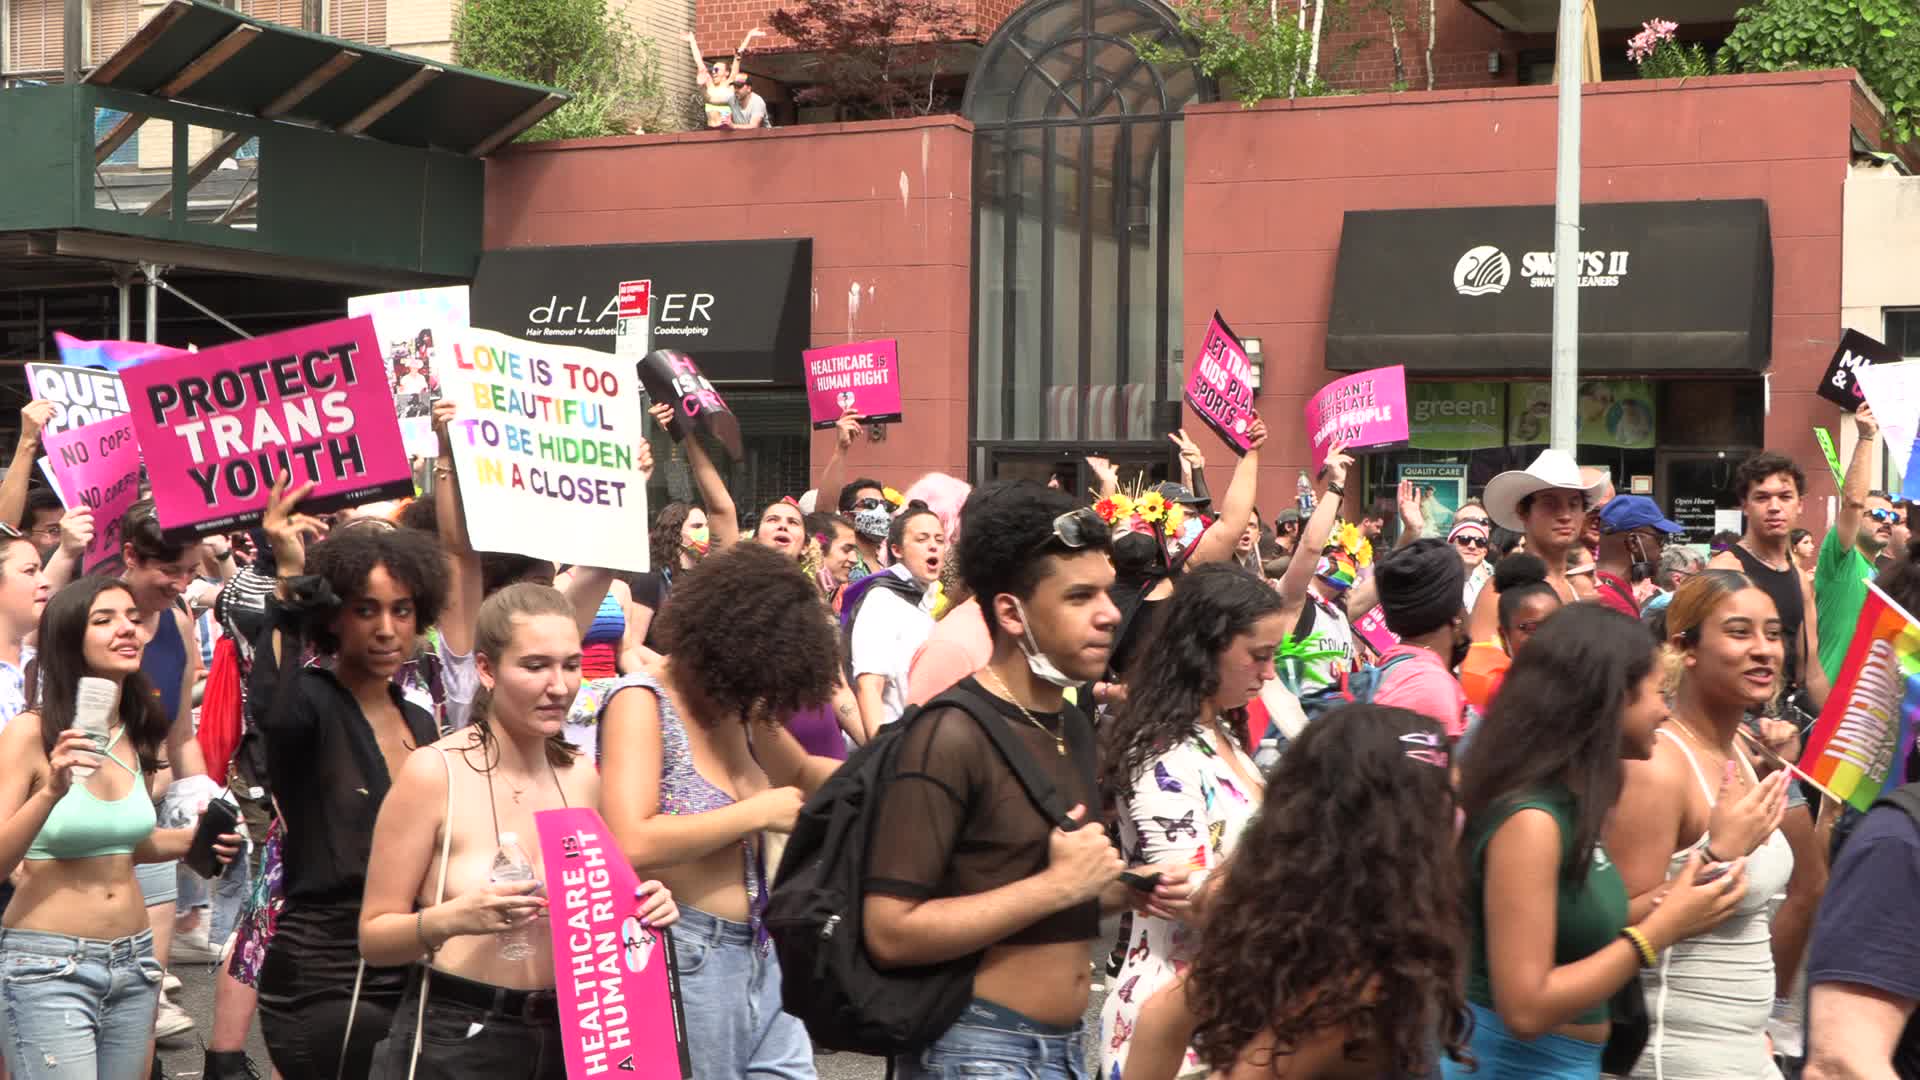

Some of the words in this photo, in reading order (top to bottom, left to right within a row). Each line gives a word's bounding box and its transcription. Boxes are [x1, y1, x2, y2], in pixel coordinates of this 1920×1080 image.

[1520, 251, 1605, 277] SW'S
[1608, 251, 1629, 275] II
[1576, 276, 1619, 287] LEANERS
[529, 293, 715, 323] drLAER
[526, 327, 543, 337] Hair
[544, 327, 576, 337] Removal
[584, 326, 617, 337] Aestheti
[654, 326, 709, 336] Coolsculpting
[453, 343, 523, 381] LOVE
[529, 357, 552, 386] IS
[564, 363, 618, 397] TOO
[810, 353, 874, 376] HEALTHCARE
[1200, 352, 1228, 391] KIDS
[1207, 329, 1227, 361] LET
[1226, 348, 1252, 390] TRA
[146, 341, 359, 428] PROTECT
[672, 374, 697, 397] IS
[817, 373, 850, 392] HUMAN
[853, 369, 889, 387] RIGHT
[1335, 379, 1375, 401] CAN'T
[1832, 370, 1848, 390] &
[473, 383, 613, 431] BEAUTIFUL
[683, 388, 730, 417] CRI
[1193, 375, 1237, 426] SPORTS
[1416, 396, 1496, 418] green!
[175, 391, 356, 464] TRANS
[1339, 406, 1392, 428] PEOPLE
[60, 441, 89, 467] NO
[100, 427, 131, 457] COPS
[457, 419, 499, 447] TO
[506, 424, 533, 456] BE
[538, 433, 632, 470] HIDDEN
[187, 433, 366, 507] YOUTH
[476, 456, 504, 486] IN
[511, 463, 525, 490] A
[530, 467, 626, 508] CLOSET
[1405, 468, 1437, 476] QUALITY
[1438, 468, 1460, 476] CARE
[78, 487, 101, 509] NO
[1674, 498, 1693, 506] Open
[1694, 497, 1715, 505] Hours
[562, 835, 581, 859] IS
[576, 829, 614, 923] RIGHT
[563, 868, 608, 1076] HEALTHCARE
[594, 930, 631, 1050] HUMAN
[618, 1053, 636, 1073] A
